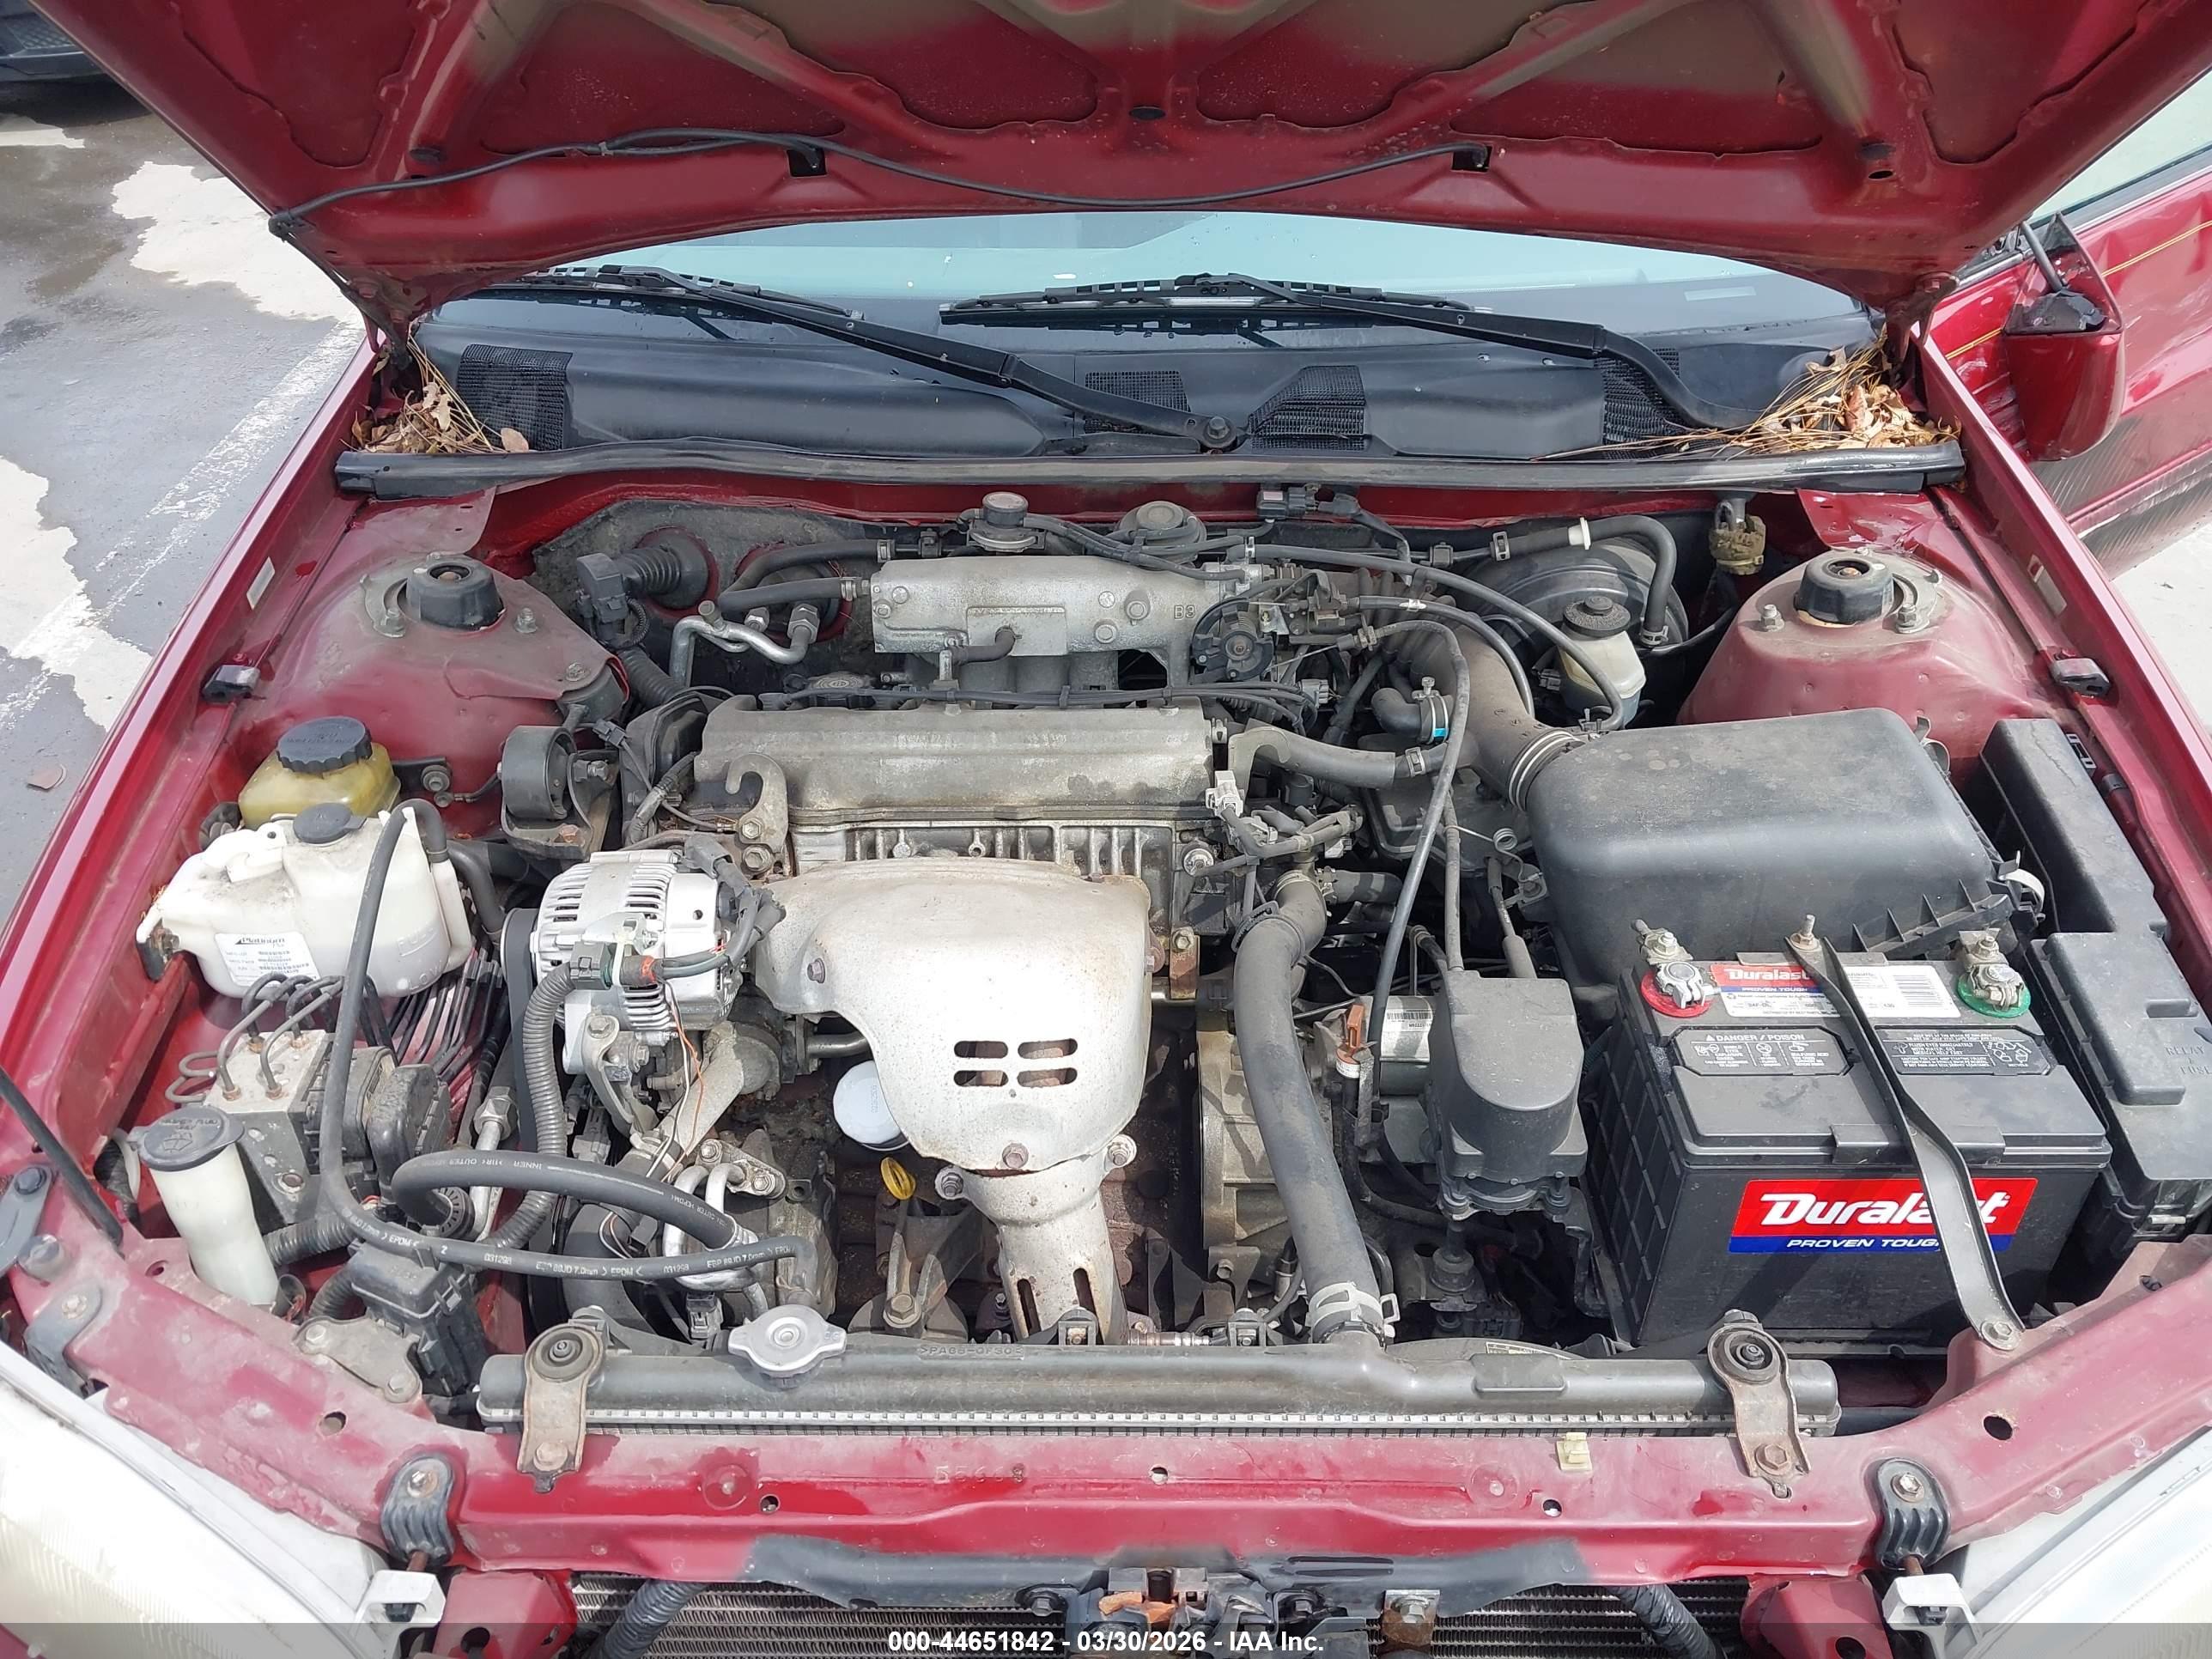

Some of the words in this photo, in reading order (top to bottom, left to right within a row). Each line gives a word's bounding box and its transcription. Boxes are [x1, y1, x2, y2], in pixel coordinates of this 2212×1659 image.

[1174, 605, 1196, 619] B3
[2166, 1046, 2204, 1055] RELAY
[513, 1161, 543, 1170] INNER
[1760, 1192, 2011, 1225] Duralat
[1786, 1239, 1875, 1248] PROVEN
[1881, 1238, 1940, 1249] TOUG
[441, 1246, 448, 1255] 2
[611, 1267, 634, 1277] EPDM
